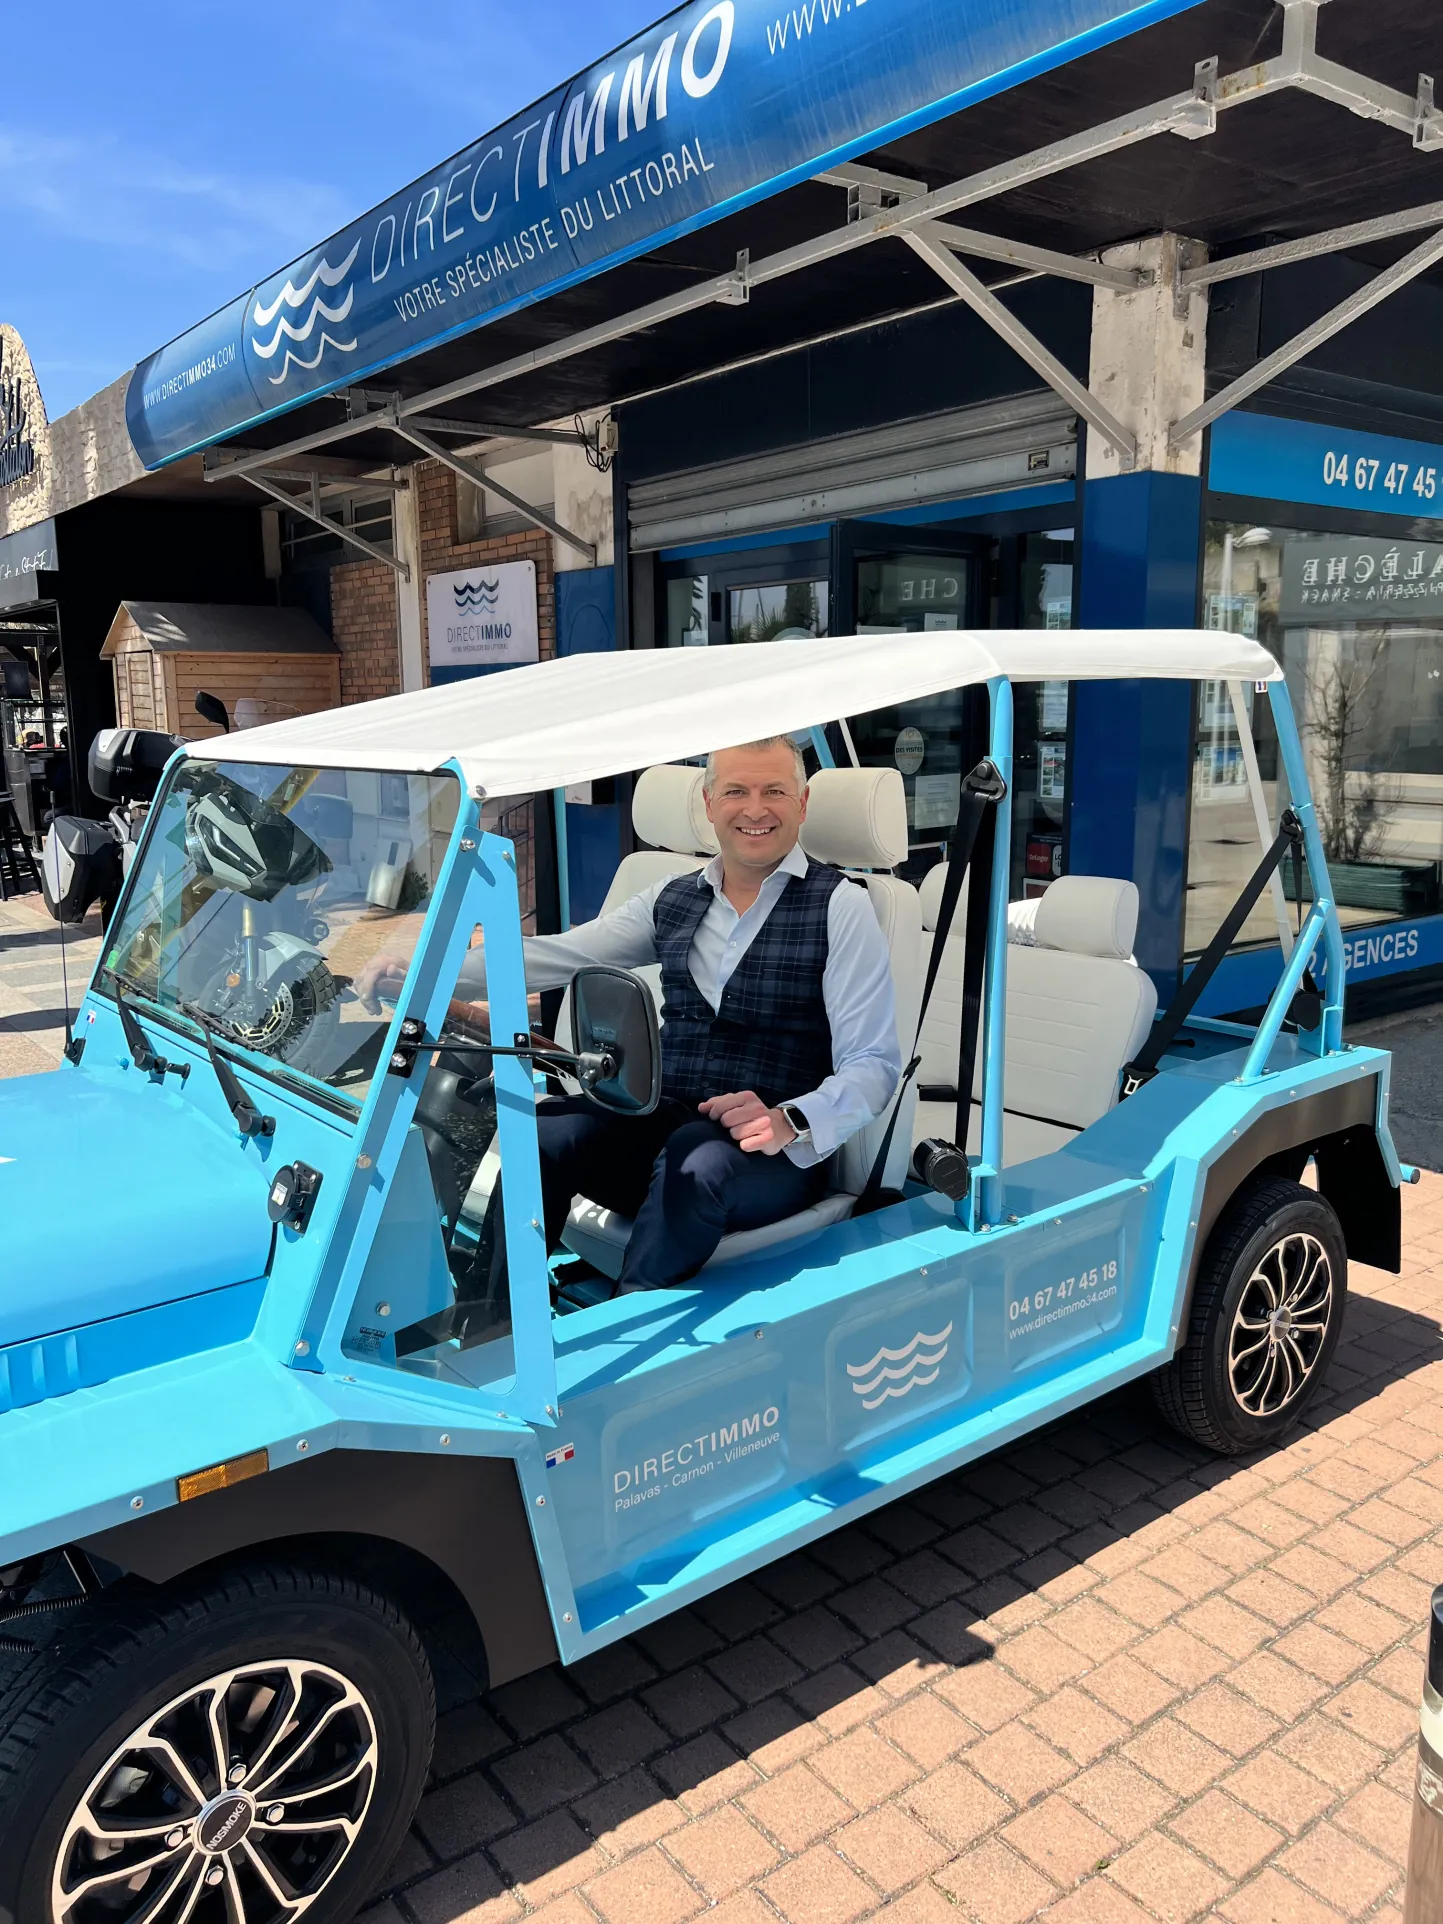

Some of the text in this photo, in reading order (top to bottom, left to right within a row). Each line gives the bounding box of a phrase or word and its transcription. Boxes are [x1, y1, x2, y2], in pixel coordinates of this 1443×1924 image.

[371, 0, 735, 283] DIRECTIMMO
[394, 137, 715, 322] VOTRE SPÉCIALISTE DU LITTORAL
[143, 342, 236, 410] WWW.DIRECTIMMO34.COM
[1323, 451, 1436, 499] 04 67 47 45
[447, 622, 512, 643] DIRECTIMMO
[1321, 929, 1419, 976] GENCES
[1009, 1260, 1117, 1320] 04 67 47 45 18
[1009, 1285, 1117, 1339] www.directimmo34.com
[614, 1406, 779, 1494] DIRECTIMMO
[615, 1485, 661, 1512] Palavas
[672, 1460, 714, 1487] Carnon
[724, 1432, 780, 1464] Villeneuve
[206, 1801, 247, 1850] NOSMOKE
